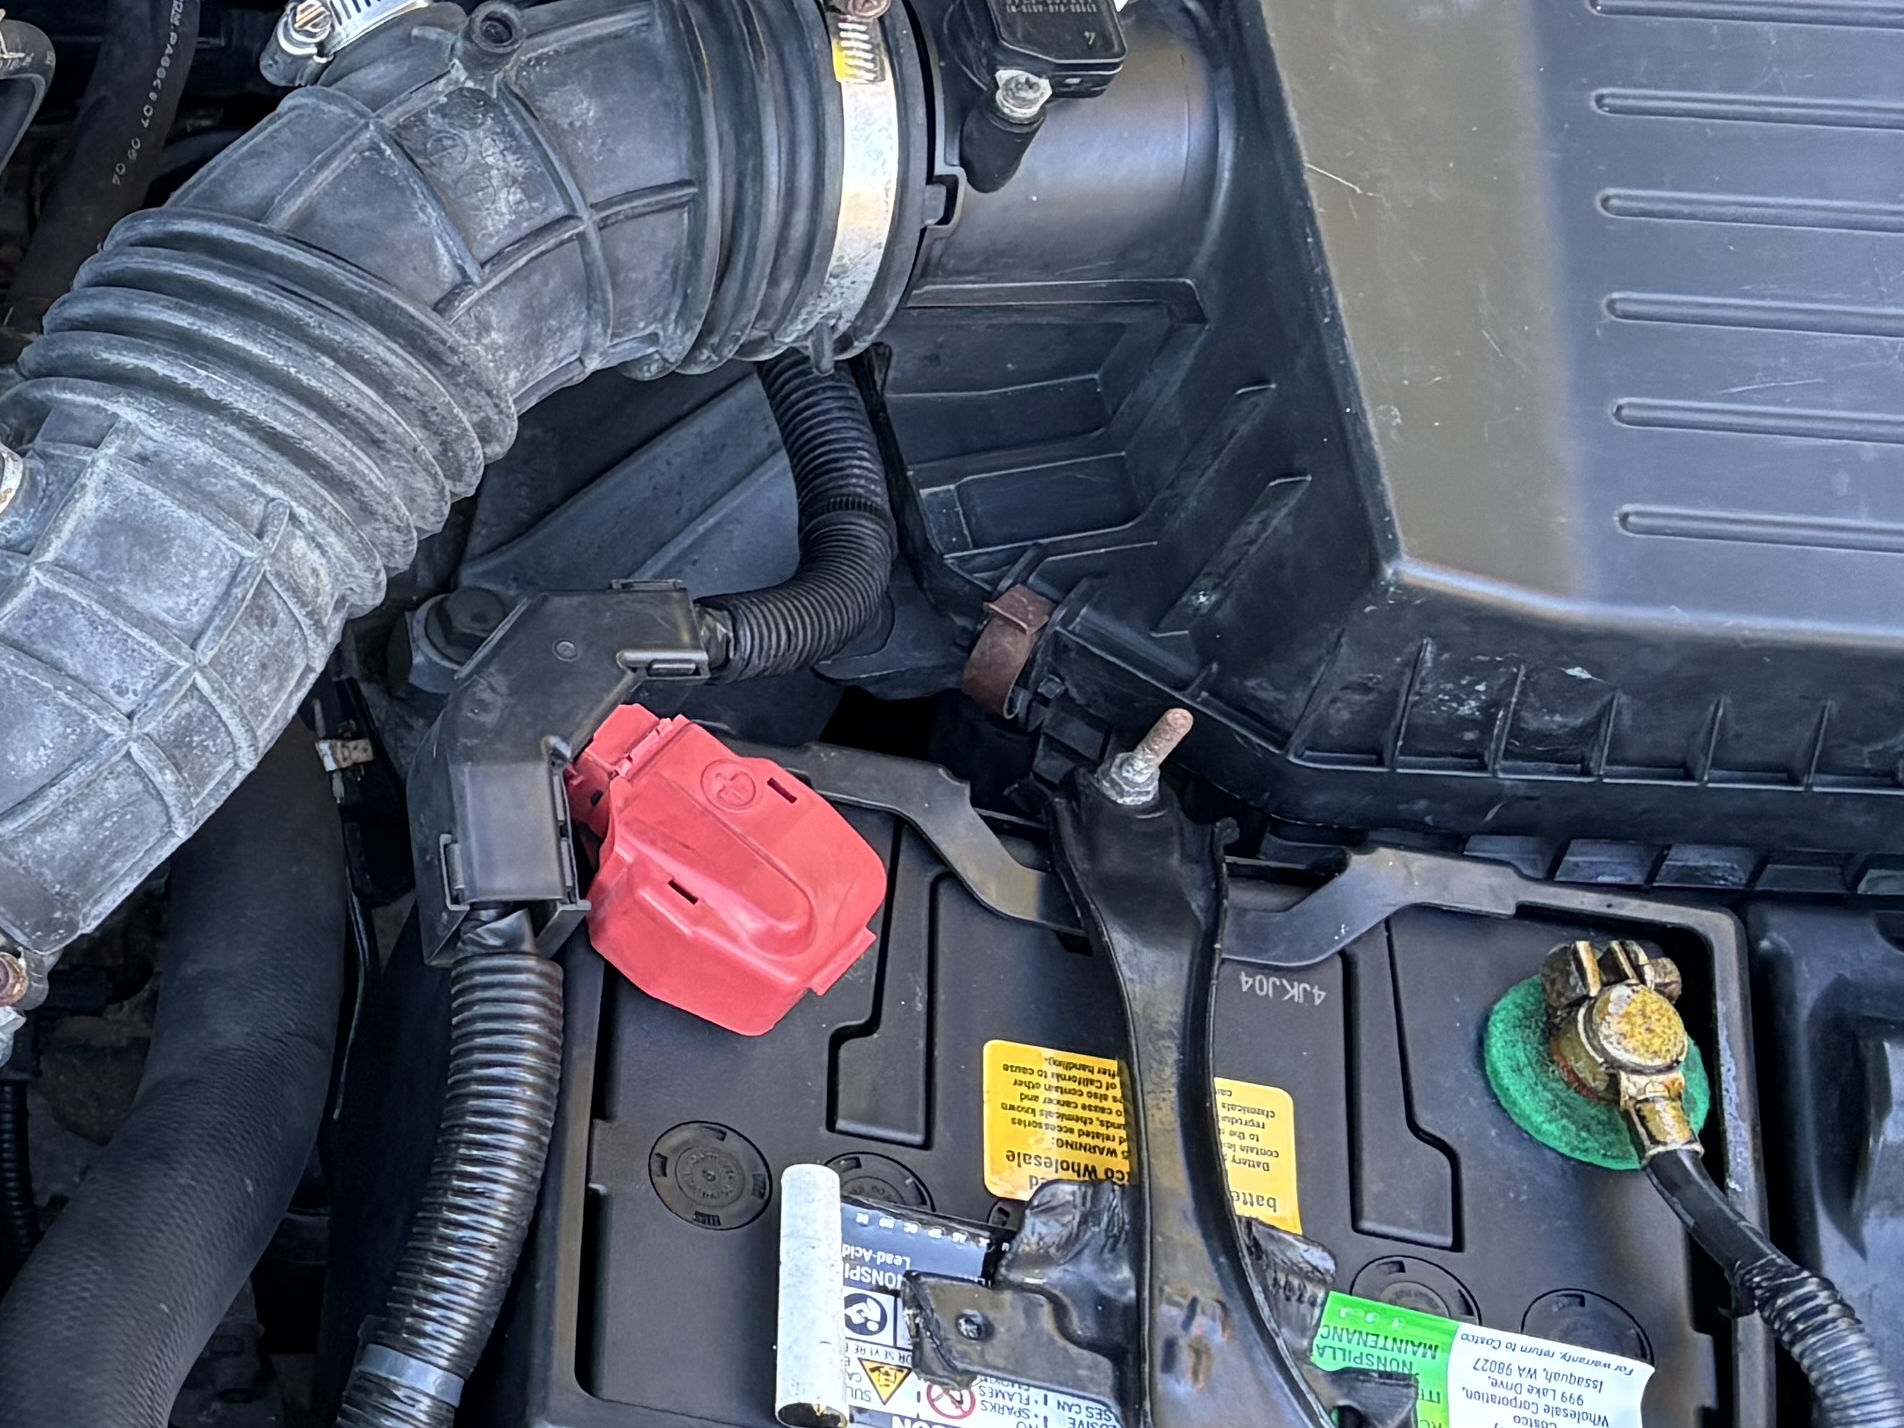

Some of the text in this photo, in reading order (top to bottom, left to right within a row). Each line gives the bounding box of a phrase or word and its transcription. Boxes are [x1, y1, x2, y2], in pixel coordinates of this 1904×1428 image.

[1083, 30, 1095, 44] 4
[1237, 971, 1327, 1006] 4JKJ04
[1036, 1069, 1116, 1090] of California to
[1019, 1093, 1039, 1102] and
[1038, 1109, 1093, 1125] chemicals
[1080, 1103, 1112, 1114] cause
[1010, 1117, 1115, 1142] related accessories
[1228, 1130, 1259, 1141] to the
[1050, 1136, 1118, 1157] WARNING:
[1238, 1144, 1279, 1158] contain
[1003, 1149, 1099, 1179] Wholesale
[1230, 1155, 1270, 1171] Battery
[1228, 1190, 1278, 1212] batte
[840, 1243, 911, 1267] Lead-Acid
[1319, 1323, 1439, 1359] MAINTENANC
[1459, 1332, 1502, 1349] Costco
[1504, 1340, 1516, 1352] to
[1519, 1343, 1555, 1359] return
[1472, 1355, 1604, 1393] Issaquah, WA 98027
[1613, 1364, 1634, 1375] For
[844, 1386, 872, 1402] SUL
[977, 1384, 1030, 1403] FLAMES
[1485, 1374, 1584, 1405] 999 Lake Drive,
[978, 1399, 1031, 1419] SPARKS
[1055, 1399, 1082, 1414] CAN
[1459, 1386, 1610, 1427] Wholesale Corporation,
